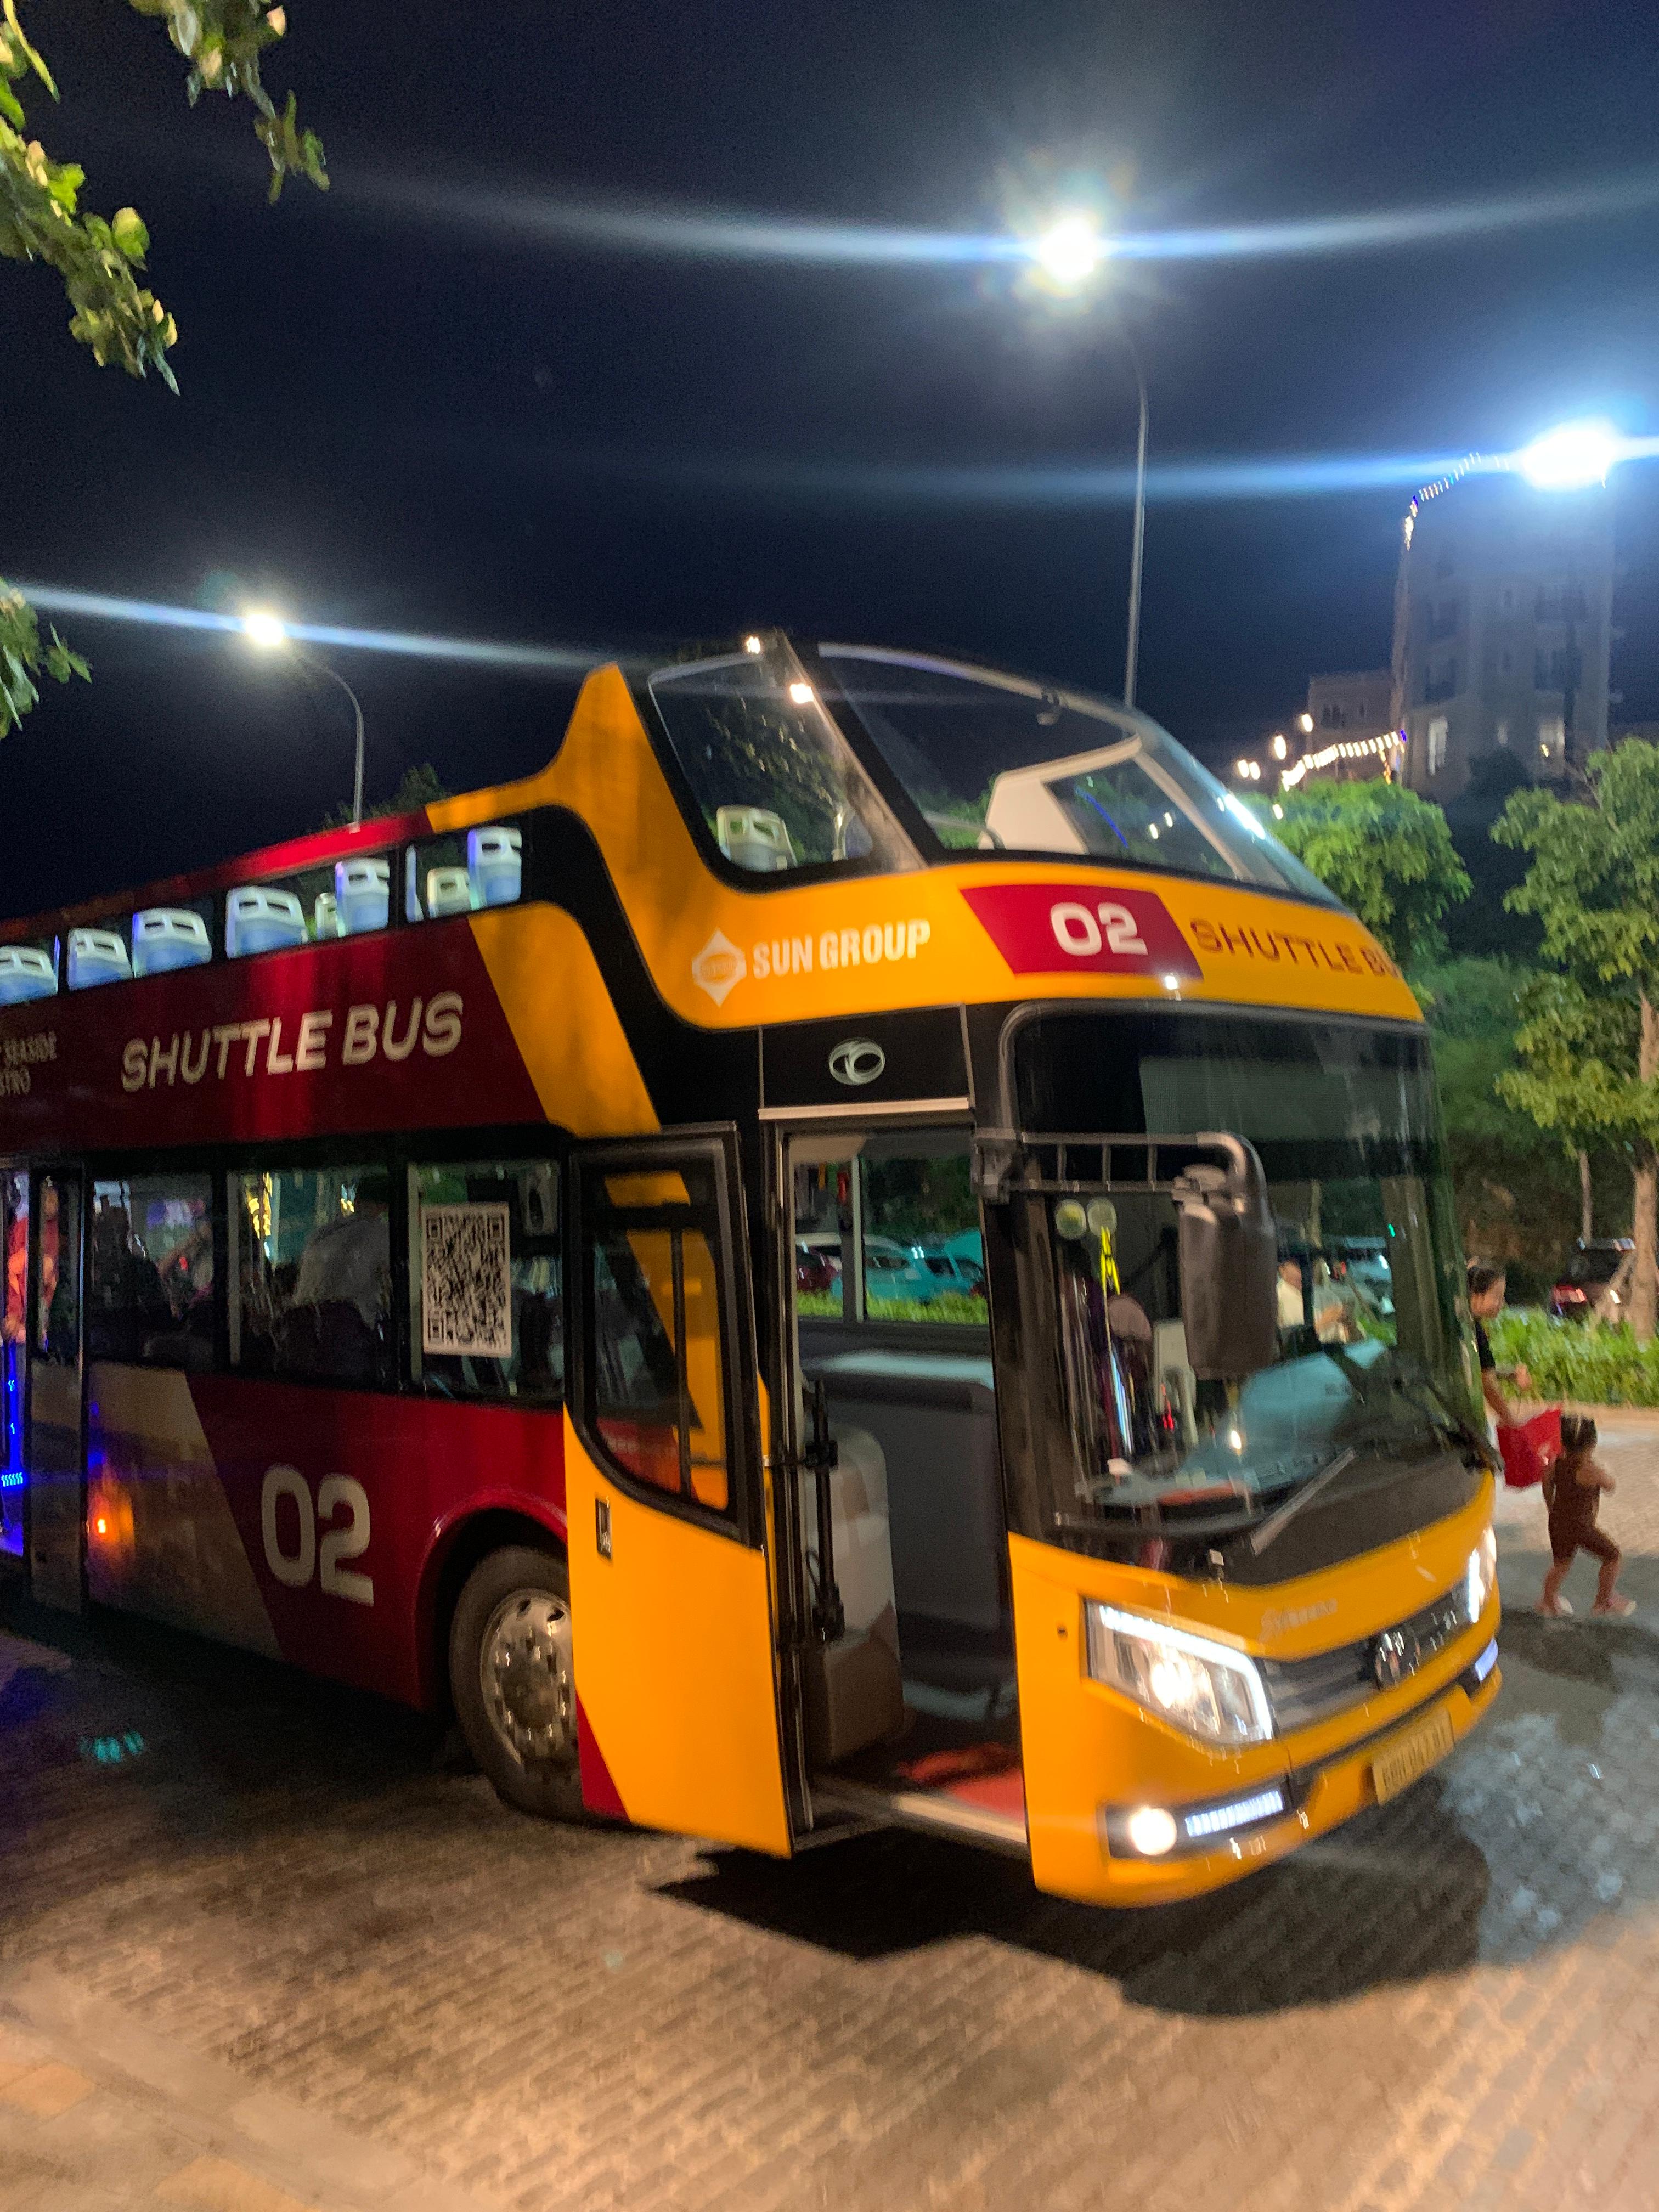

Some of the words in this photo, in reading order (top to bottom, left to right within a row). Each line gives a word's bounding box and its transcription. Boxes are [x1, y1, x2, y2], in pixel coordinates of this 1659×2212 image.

[752, 935, 813, 979] SUN
[819, 918, 931, 970] GROUP
[1050, 902, 1148, 956] 02
[1190, 918, 1363, 975] SHUTTLE
[121, 1009, 333, 1092] SHUTTLE
[342, 991, 463, 1065] BUS
[262, 1464, 374, 1606] 02
